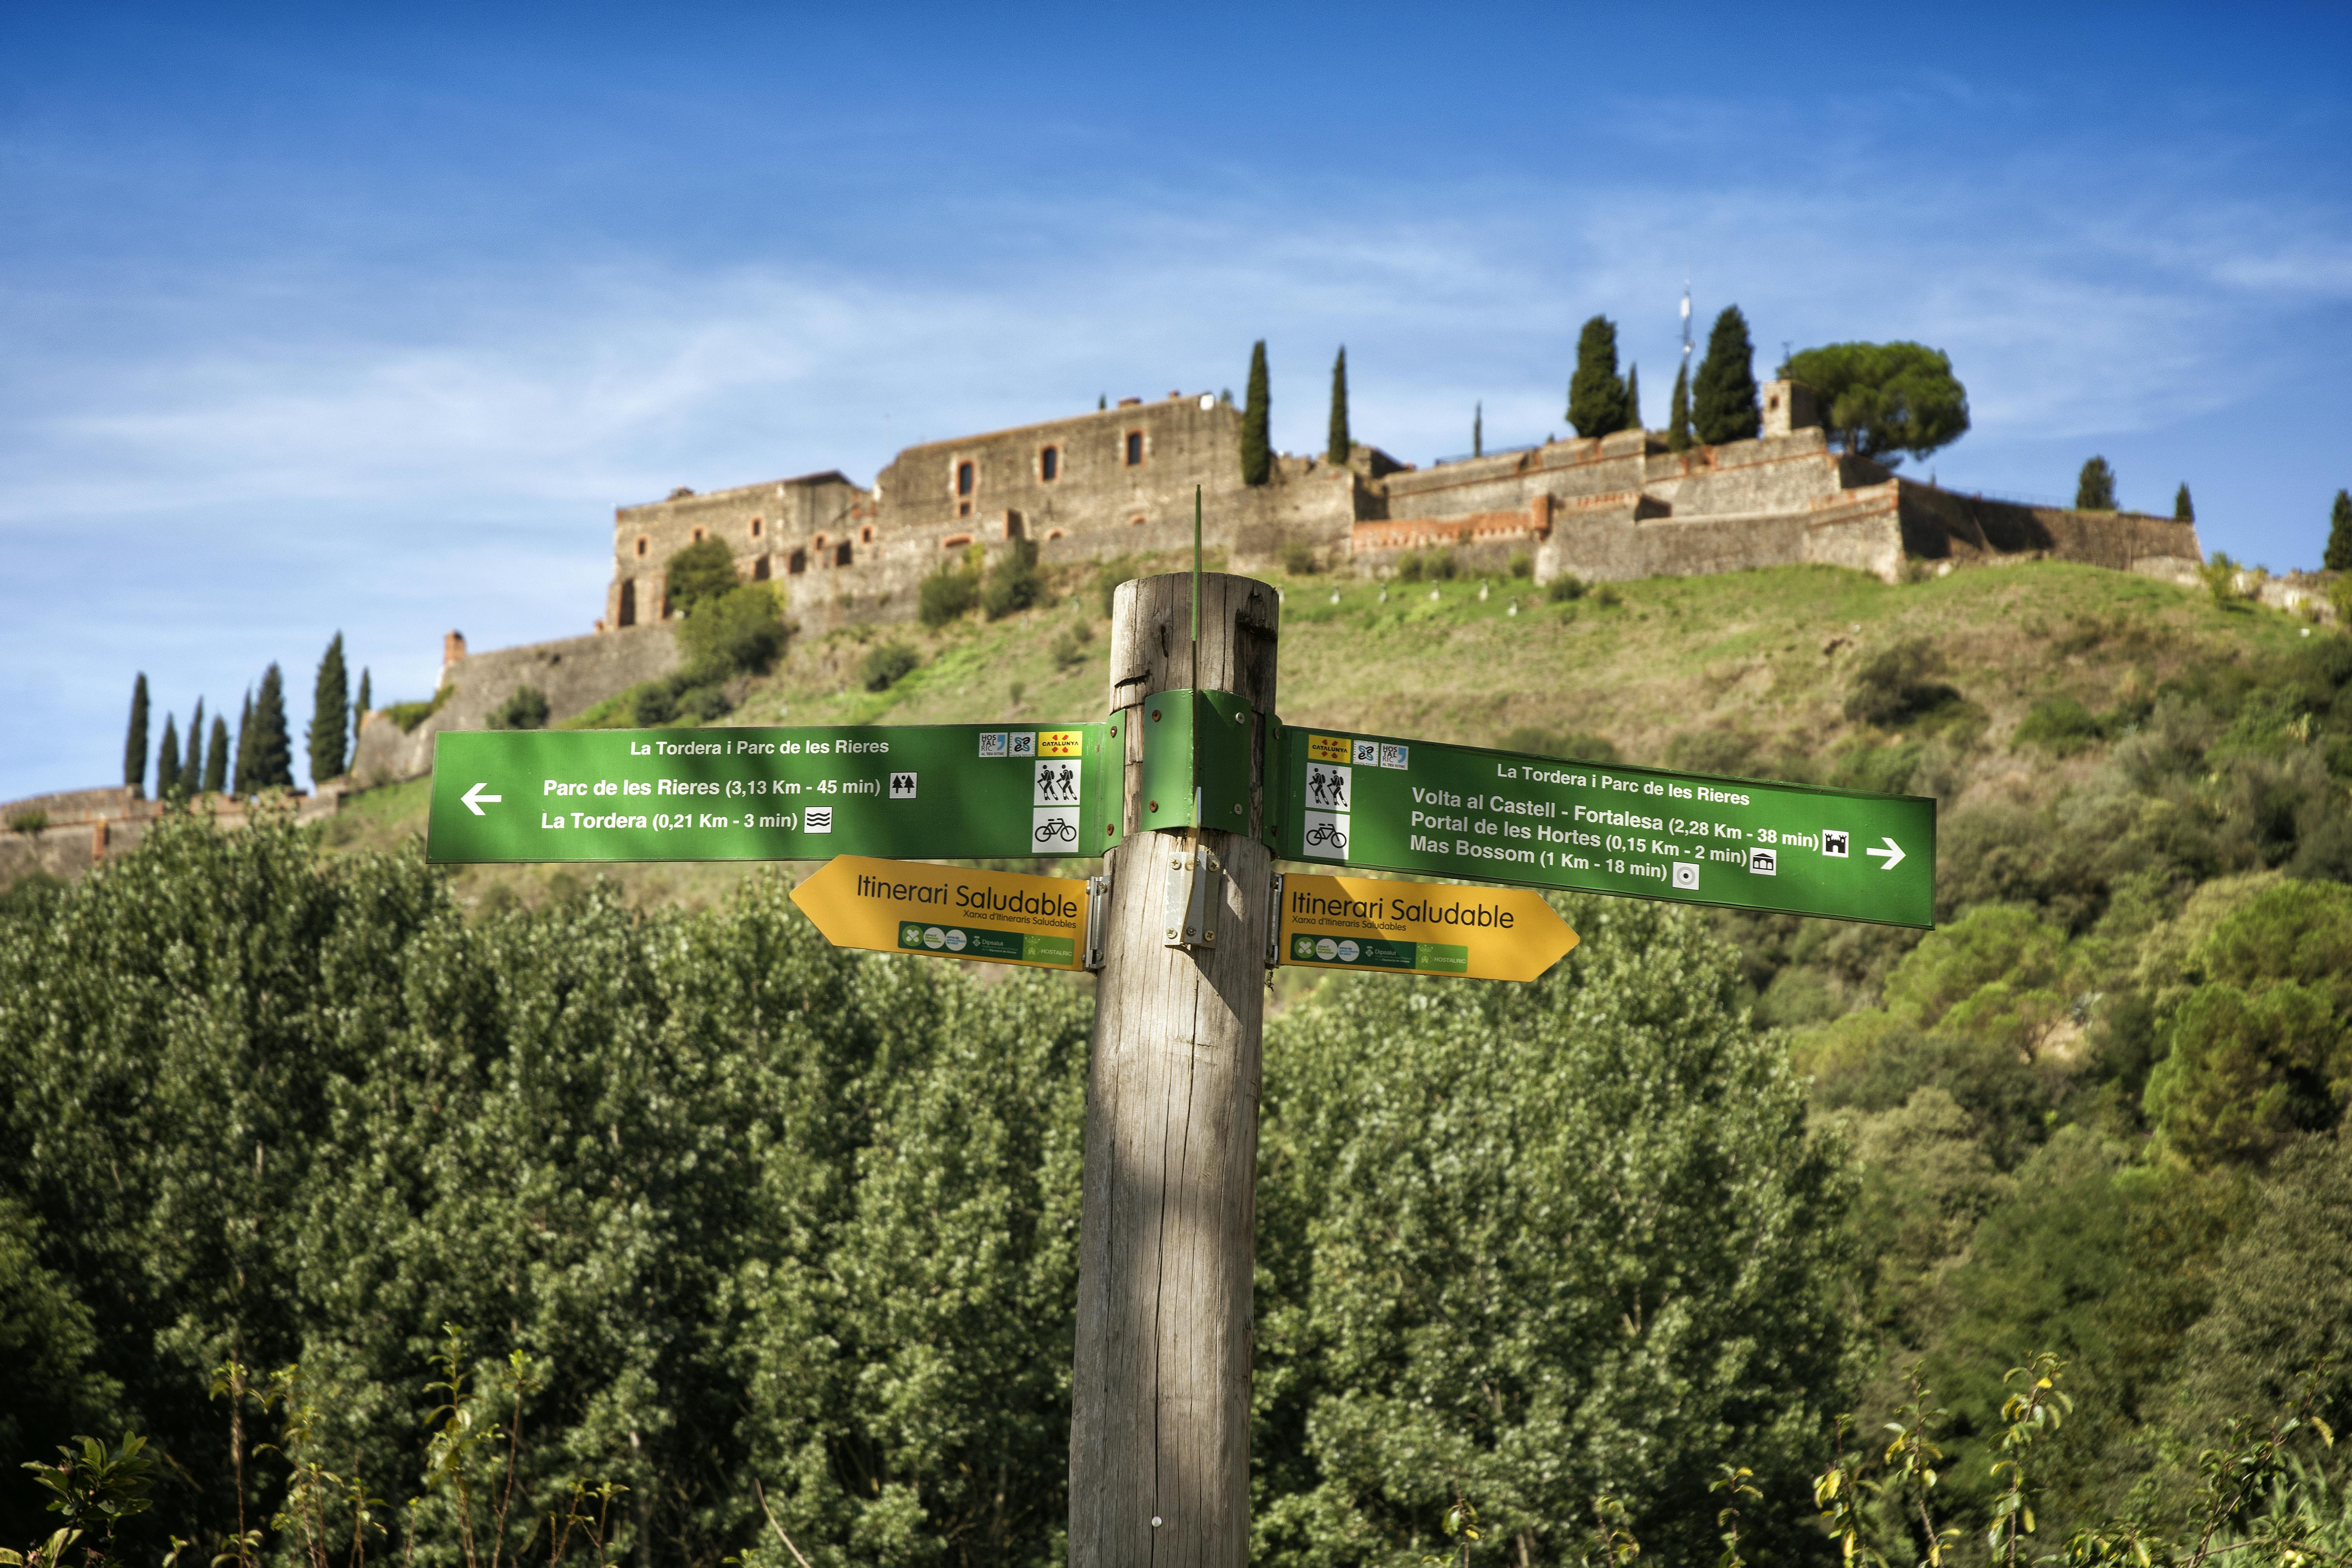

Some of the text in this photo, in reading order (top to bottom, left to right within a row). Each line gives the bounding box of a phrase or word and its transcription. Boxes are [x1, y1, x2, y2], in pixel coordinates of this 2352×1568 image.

[631, 740, 889, 755] La Tordera i Parc de les Rieres
[1312, 745, 1348, 753] CATALUNYA
[544, 780, 587, 795] Parc
[593, 780, 617, 795] de
[624, 780, 651, 795] les
[658, 779, 719, 795] Rieres
[726, 780, 766, 798] (3,13
[773, 780, 800, 794] Km
[817, 780, 837, 793] 45
[843, 779, 880, 796] min)
[1498, 764, 1749, 805] La Tordera i Parc de les Rieres
[542, 813, 564, 828] La
[571, 813, 646, 828] Tordera
[653, 814, 691, 831] (0,21
[700, 814, 727, 828] Km
[744, 814, 754, 828] 3
[760, 813, 797, 830] min)
[1412, 787, 1460, 807] Volta
[1467, 795, 1483, 809] al
[1490, 796, 1555, 817] Castell
[1575, 806, 1662, 830] Fortalesa
[1669, 818, 1708, 836] (2,28
[1715, 823, 1741, 839] Km
[1757, 829, 1777, 843] 38
[1782, 833, 1818, 851] min)
[1412, 811, 1467, 831] Portal
[1475, 819, 1497, 835] de
[1504, 822, 1531, 838] les
[1538, 825, 1600, 846] Hortes
[1606, 835, 1646, 852] (0,15
[1652, 840, 1679, 856] Km
[1695, 846, 1704, 858] 2
[1710, 848, 1746, 867] min)
[1411, 835, 1448, 853] Mas
[1456, 840, 1534, 863] Bossom
[1540, 851, 1553, 868] (1
[1562, 853, 1588, 869] Km
[1606, 859, 1624, 873] 18
[1630, 863, 1666, 881] min)
[858, 875, 1077, 918] Itinerari Saludable
[1292, 891, 1514, 928] Itinerari Saludable
[963, 910, 987, 920] Xarxa
[1033, 916, 1076, 929] Saludables
[1292, 915, 1316, 924] Xarxa
[1362, 920, 1406, 931] Saludables
[1041, 948, 1072, 956] HOSTALRIC
